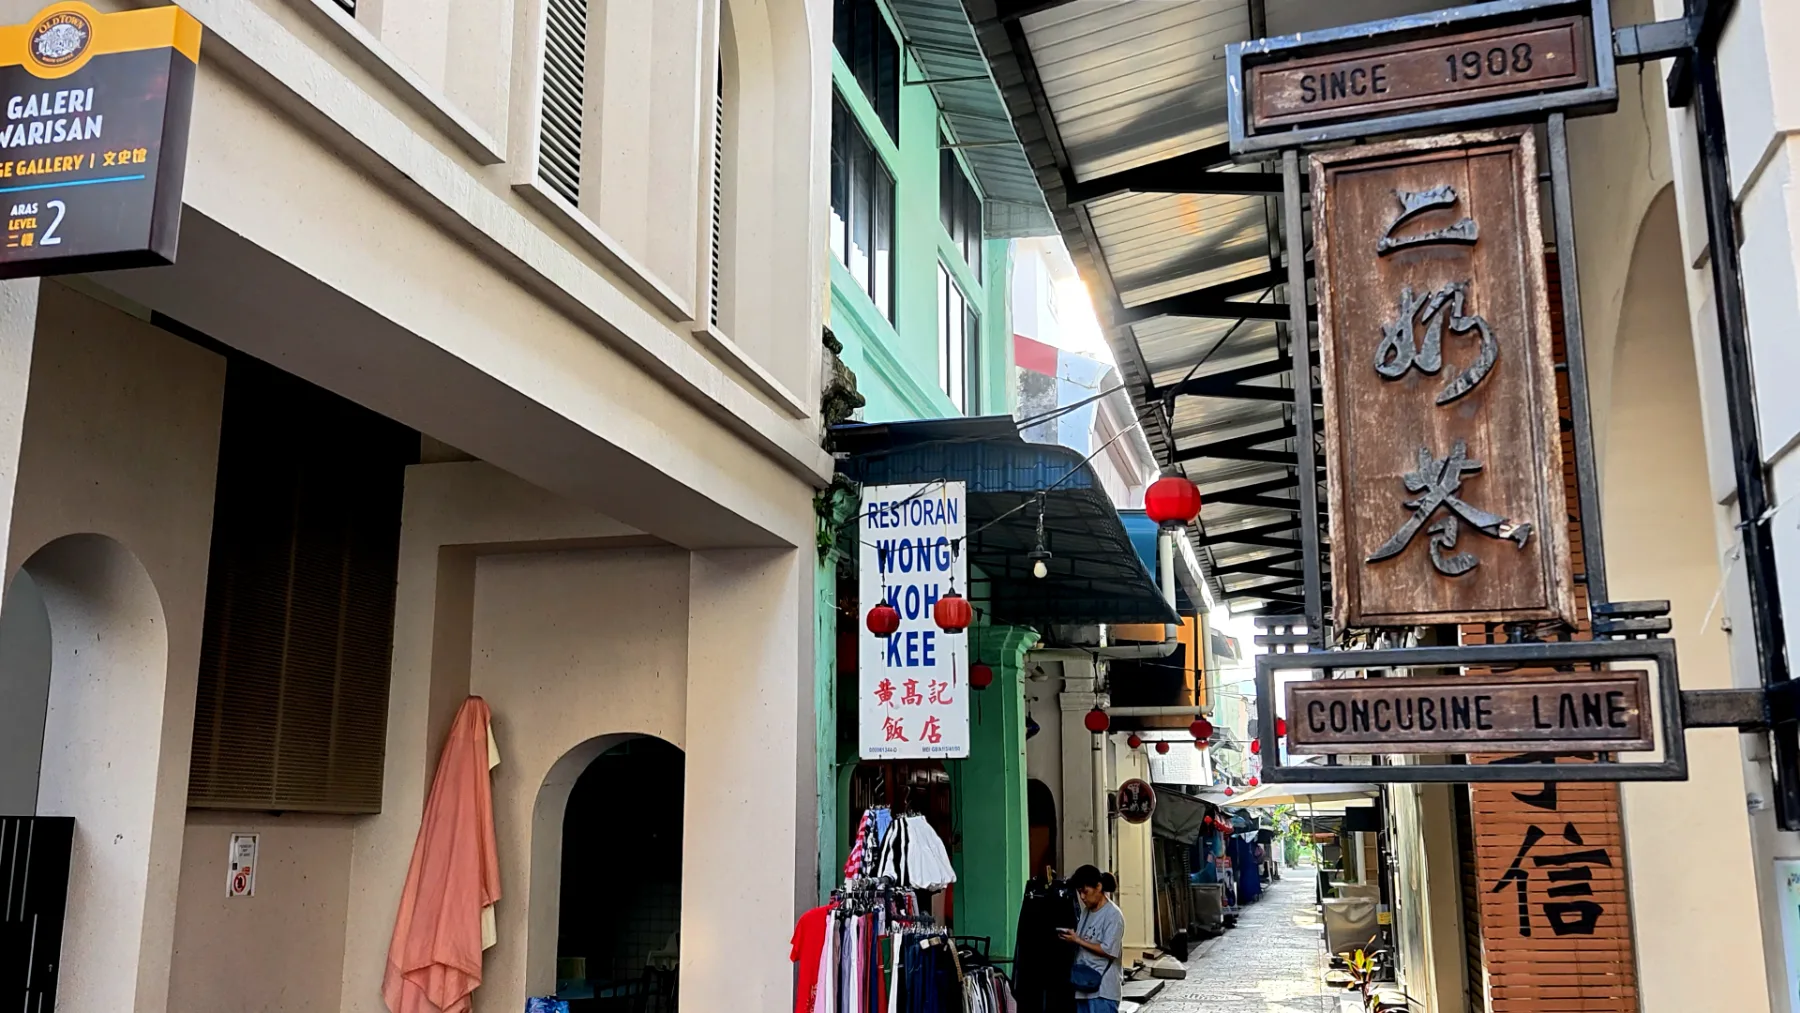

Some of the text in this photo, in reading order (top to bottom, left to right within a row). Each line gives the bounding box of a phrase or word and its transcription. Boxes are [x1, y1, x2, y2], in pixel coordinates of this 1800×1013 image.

[1300, 42, 1533, 104] SINCE 1908
[7, 88, 94, 120] GALERI
[16, 154, 84, 177] GALLERY
[8, 217, 38, 231] LEVEL
[10, 203, 39, 217] ARAS
[40, 200, 66, 246] 2
[1366, 184, 1534, 577] 二奶巷
[868, 497, 958, 529] RESTORAN
[877, 536, 951, 574] WONG
[887, 583, 939, 620] KOH
[887, 630, 936, 667] KEE
[881, 715, 942, 744] 飯店
[1307, 690, 1628, 733] CONCUBINE LANE
